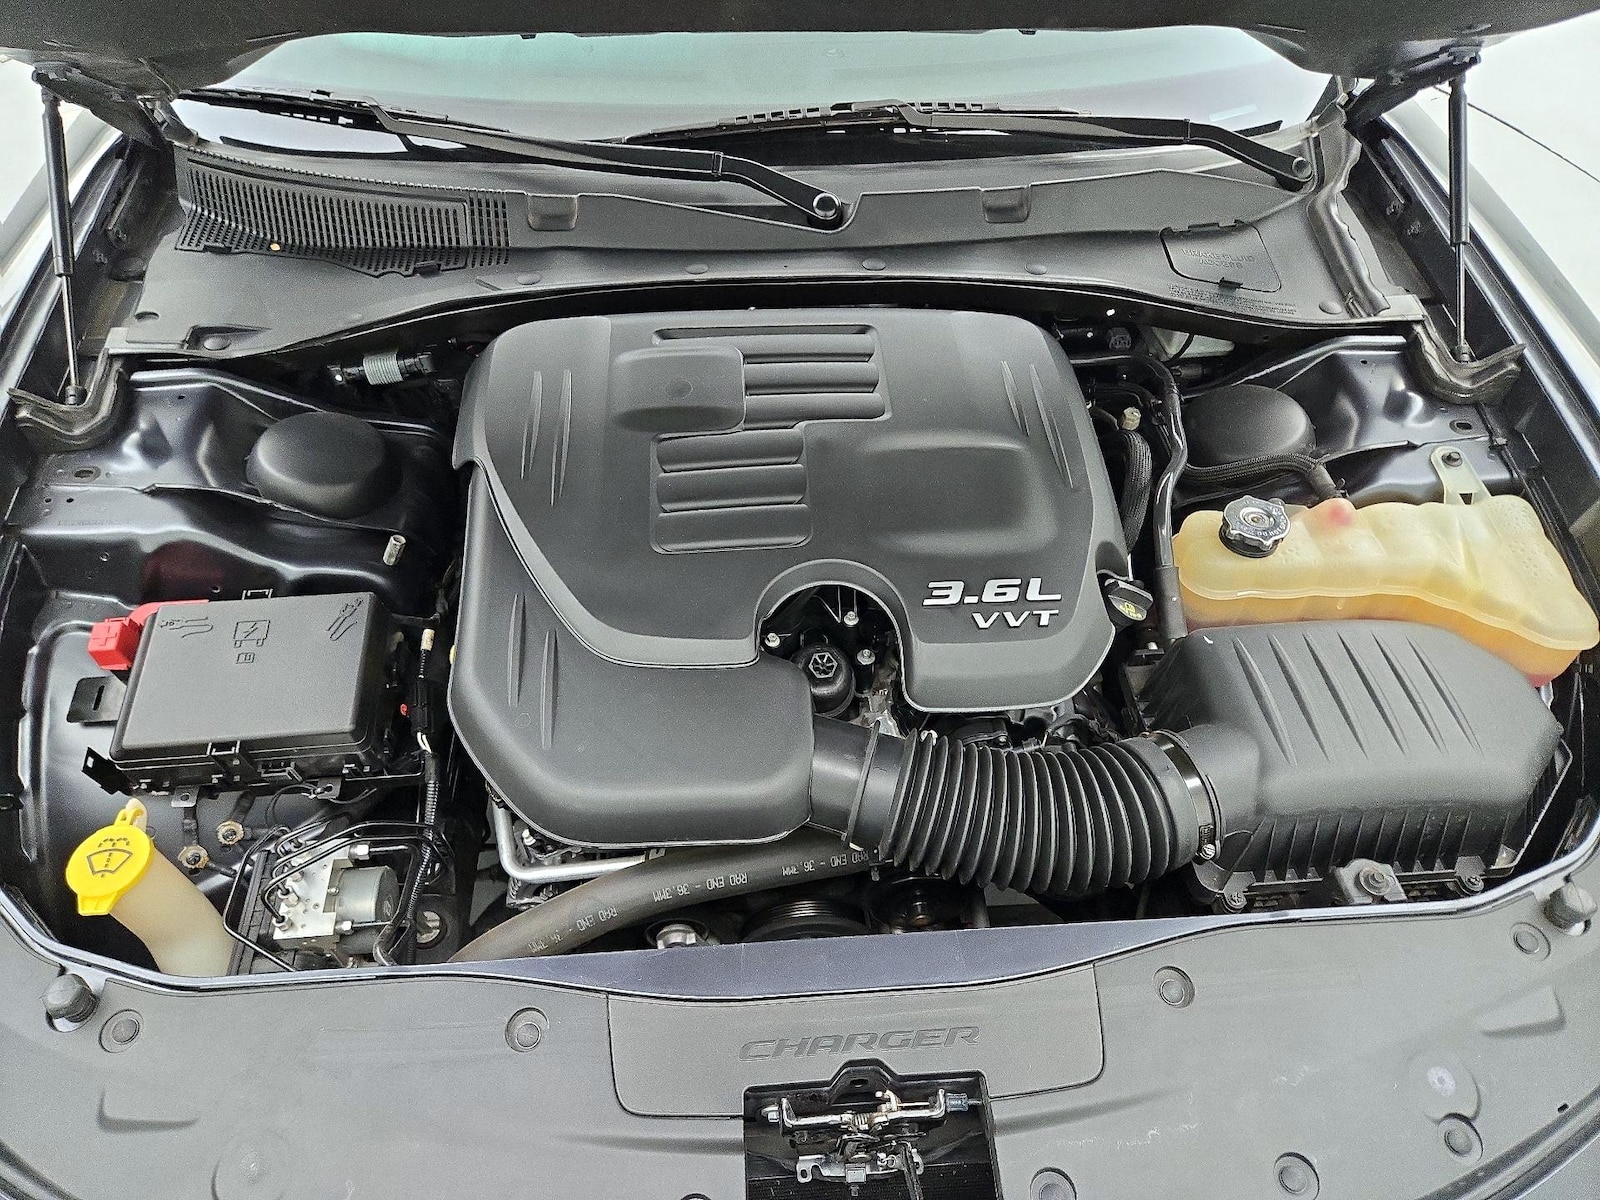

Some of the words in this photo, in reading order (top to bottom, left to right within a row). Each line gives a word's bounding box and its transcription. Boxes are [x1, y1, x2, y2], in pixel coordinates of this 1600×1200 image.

[1222, 253, 1256, 263] FLUID
[922, 577, 1062, 606] 3.6L
[971, 609, 1059, 630] VVT
[830, 853, 847, 868] END
[851, 850, 869, 864] RAD
[706, 876, 725, 890] END
[729, 872, 748, 886] RAD
[652, 883, 690, 903] 36.3MM
[598, 905, 618, 922] RAD
[576, 914, 595, 932] END
[739, 1026, 980, 1061] CHARGER
